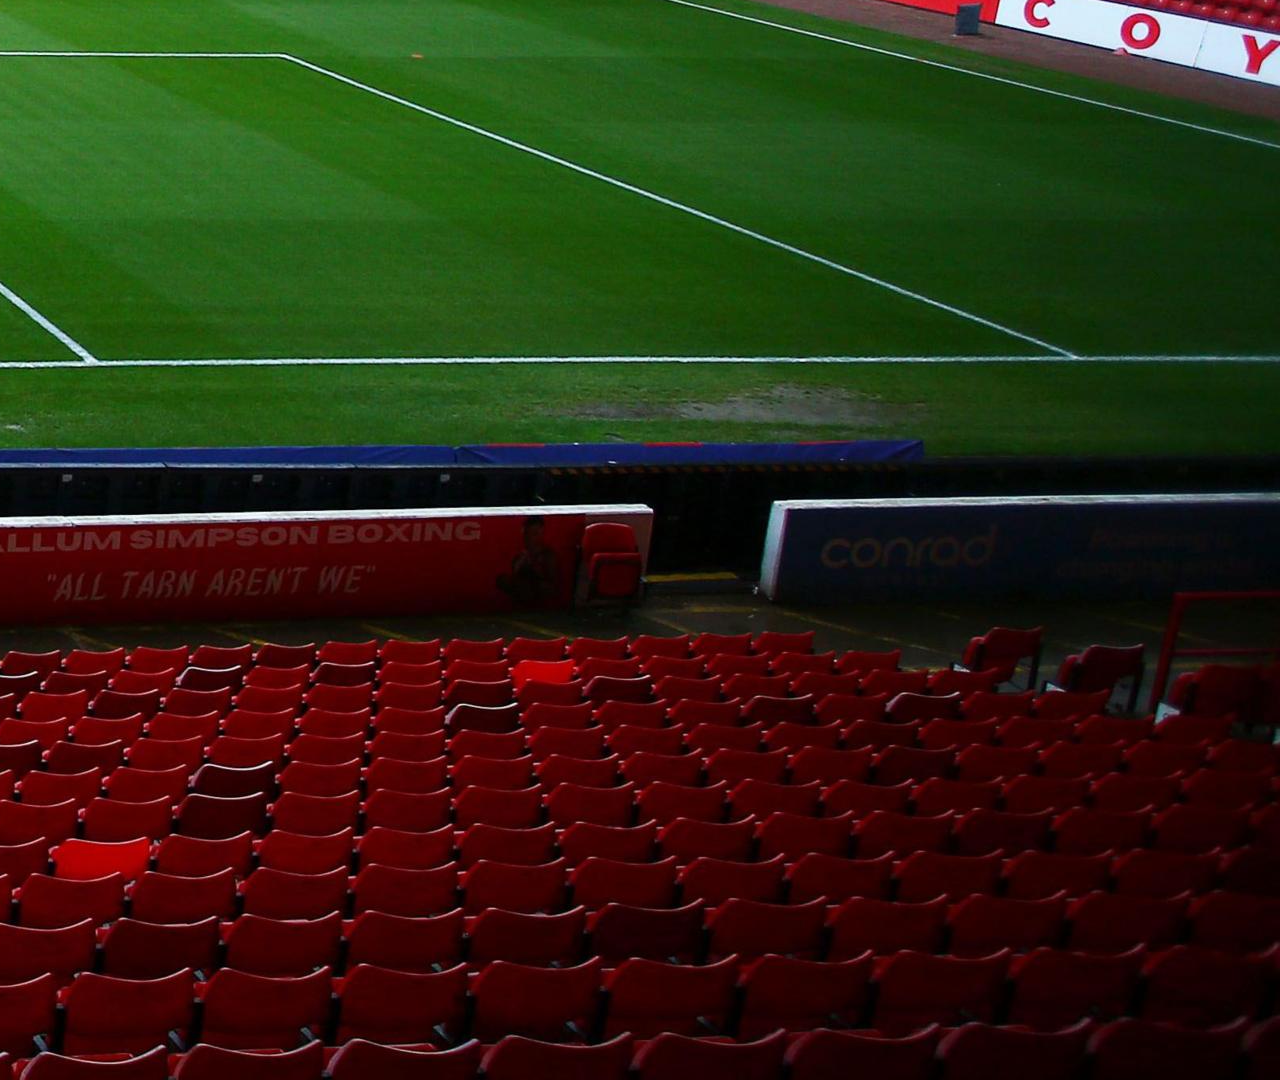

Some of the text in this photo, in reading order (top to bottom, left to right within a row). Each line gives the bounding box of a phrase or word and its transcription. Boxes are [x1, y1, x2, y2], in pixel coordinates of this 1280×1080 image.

[129, 526, 329, 552] SIMPSON
[335, 521, 482, 545] BOXING
[820, 524, 998, 569] conrad
[47, 563, 377, 603] "ALL TARN AREN'T WE"
